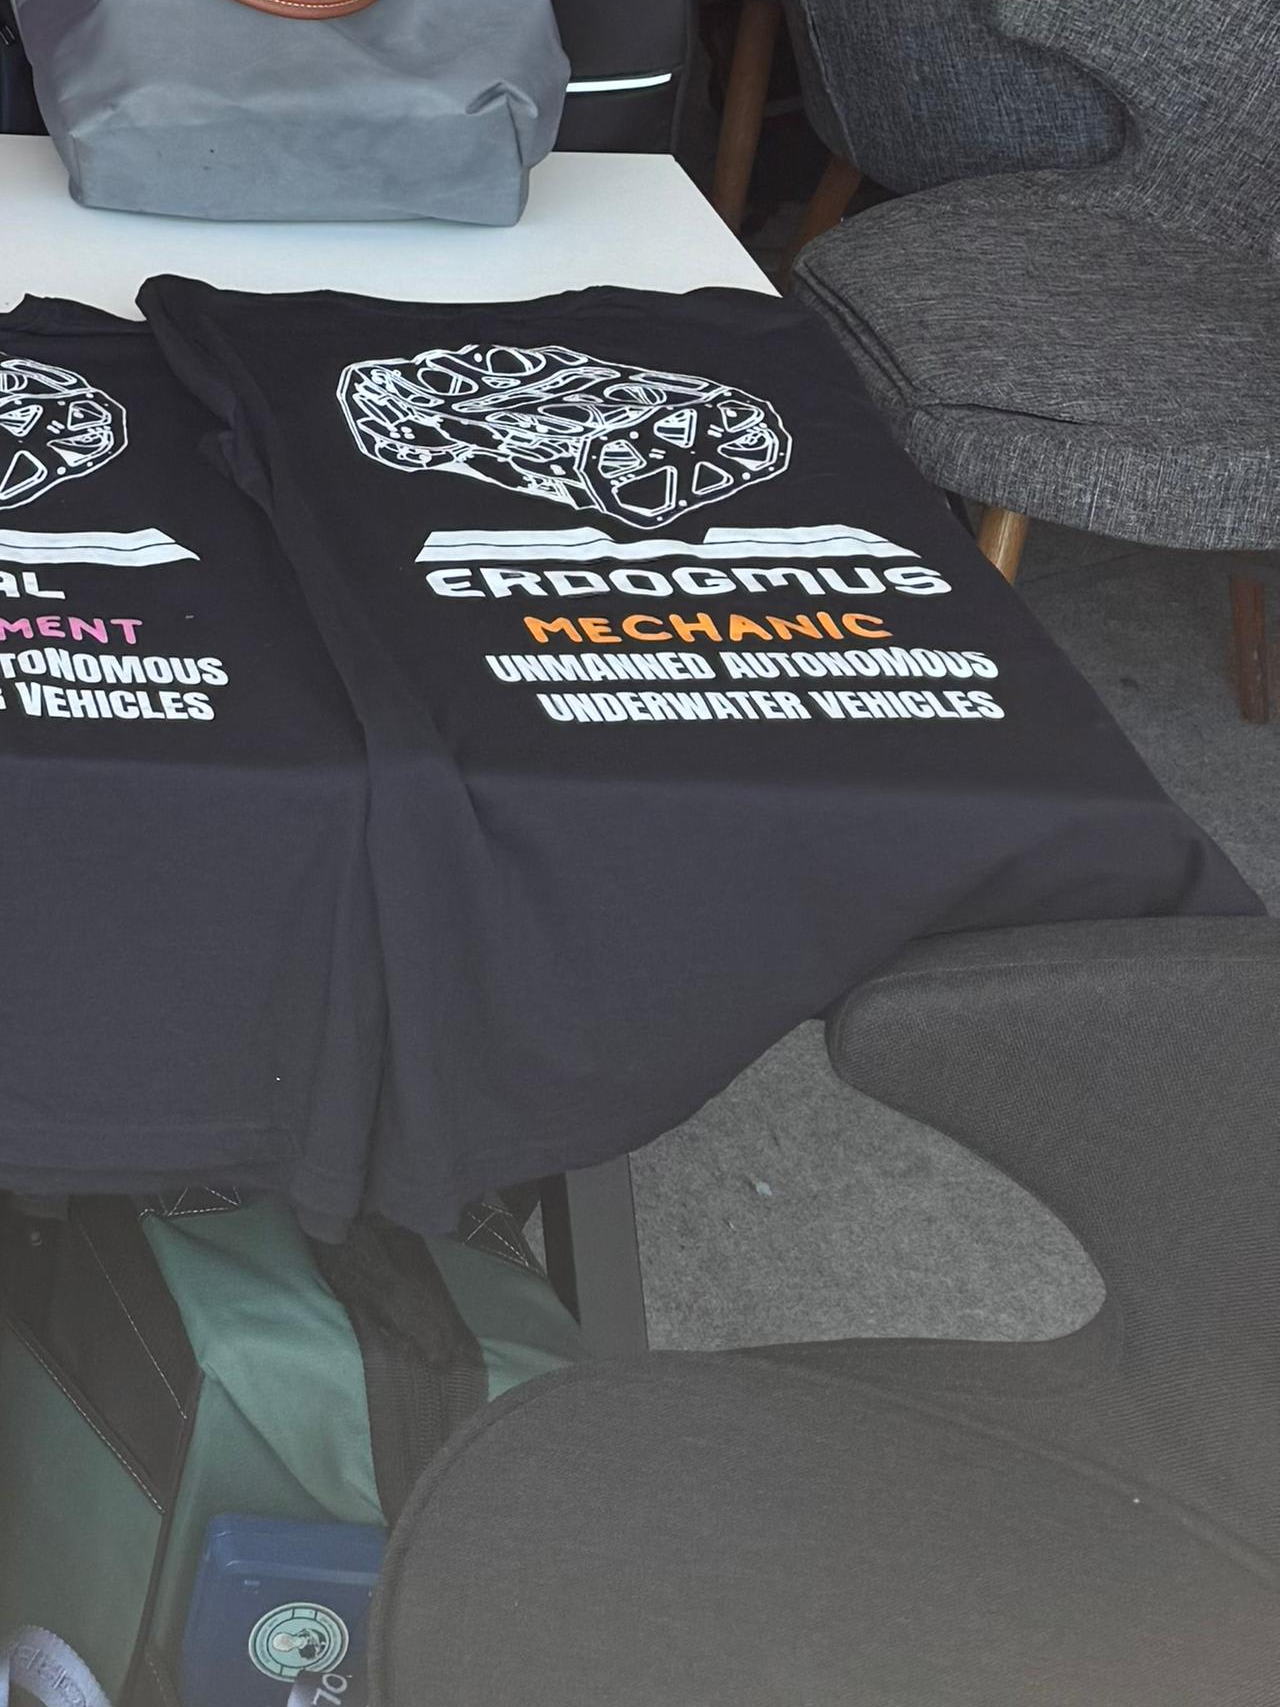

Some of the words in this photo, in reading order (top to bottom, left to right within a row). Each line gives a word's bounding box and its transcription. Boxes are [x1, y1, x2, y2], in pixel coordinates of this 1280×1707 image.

[426, 566, 952, 599] ERDOGMUS
[523, 611, 893, 643] MECHANIC
[486, 652, 715, 683] UNMANNED
[727, 646, 998, 682] AUTONOMOUS
[15, 685, 215, 721] VEHICLES
[537, 691, 803, 722] UNDERWATER
[815, 688, 1005, 720] VEHICLES
